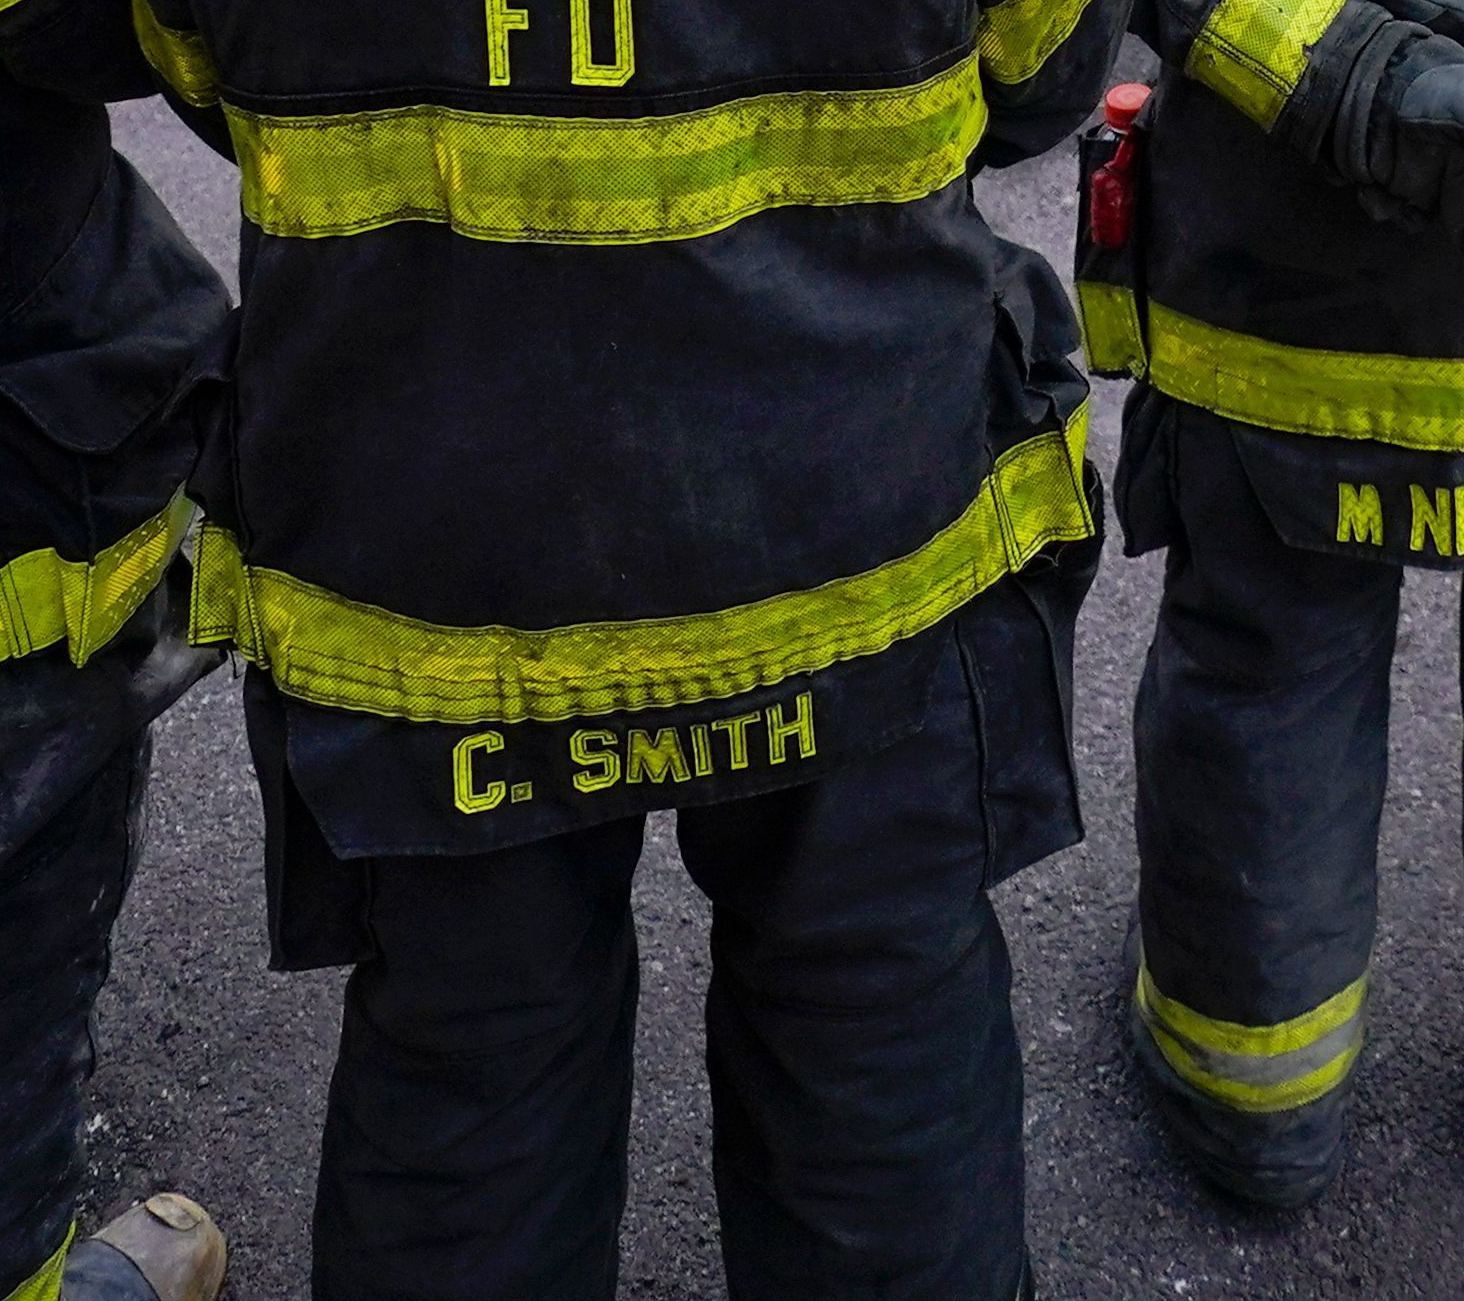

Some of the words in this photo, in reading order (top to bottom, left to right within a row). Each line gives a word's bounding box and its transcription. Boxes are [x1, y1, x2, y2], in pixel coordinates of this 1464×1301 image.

[1337, 483, 1383, 546] M
[452, 730, 532, 814] C.
[569, 691, 817, 793] SMITH
